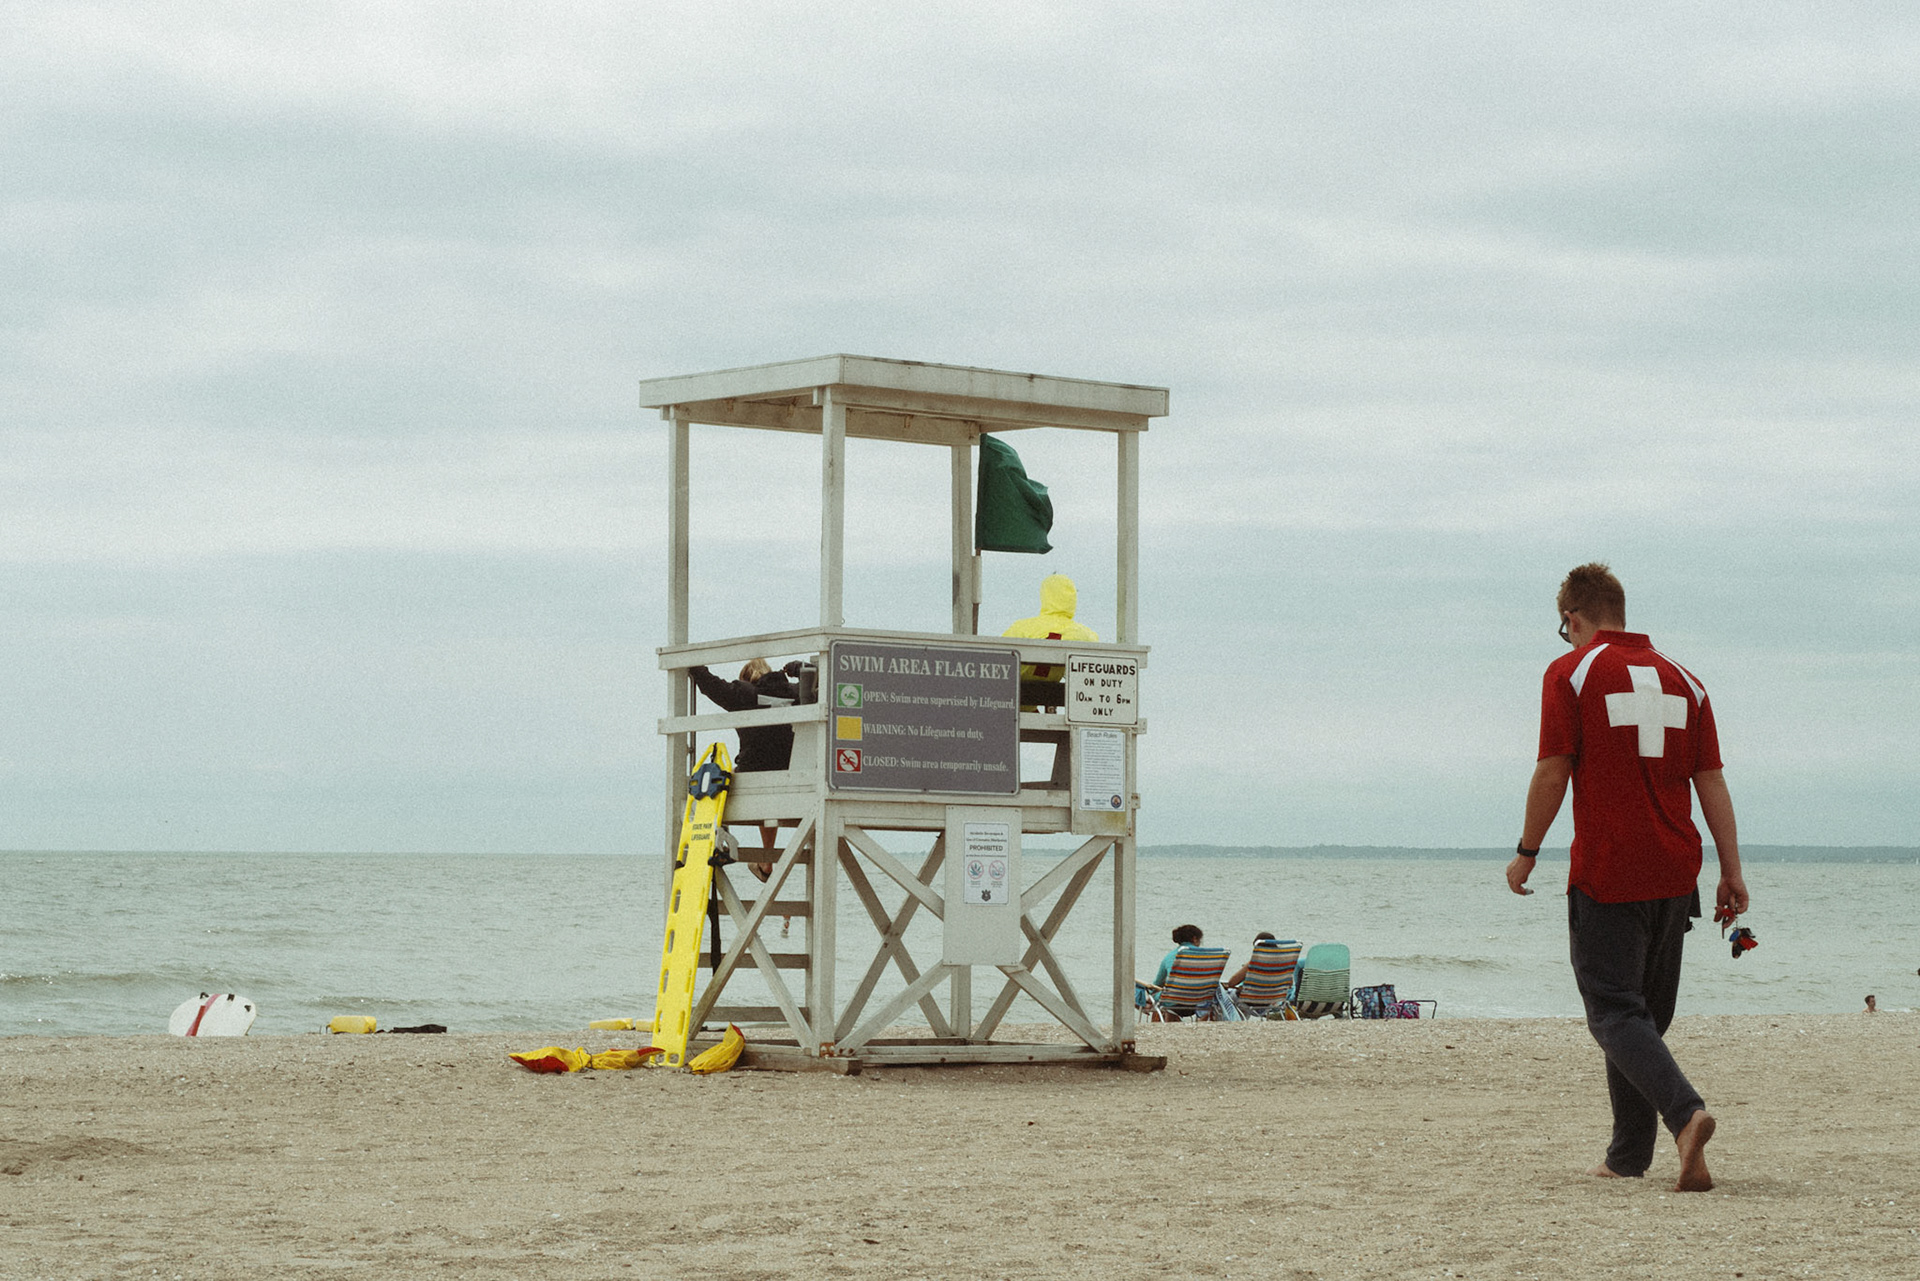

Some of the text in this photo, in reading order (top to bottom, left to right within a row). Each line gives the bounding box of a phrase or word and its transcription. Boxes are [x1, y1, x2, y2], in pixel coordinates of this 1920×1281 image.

[839, 654, 1012, 680] SWIM AREA FLAG KEY
[1071, 662, 1136, 676] LIFEGUARDS
[1083, 678, 1123, 688] ON DUTY
[863, 690, 1016, 710] OPEN: Swim area supervised by Lifeguard.
[1099, 694, 1111, 703] TO
[1092, 707, 1114, 716] ONLY
[863, 723, 907, 736] WARNING:
[907, 724, 919, 736] No
[920, 725, 956, 740] Lifeguard
[956, 729, 966, 738] on
[863, 755, 1009, 773] CLOSED: Swim area temporarily unsafe.
